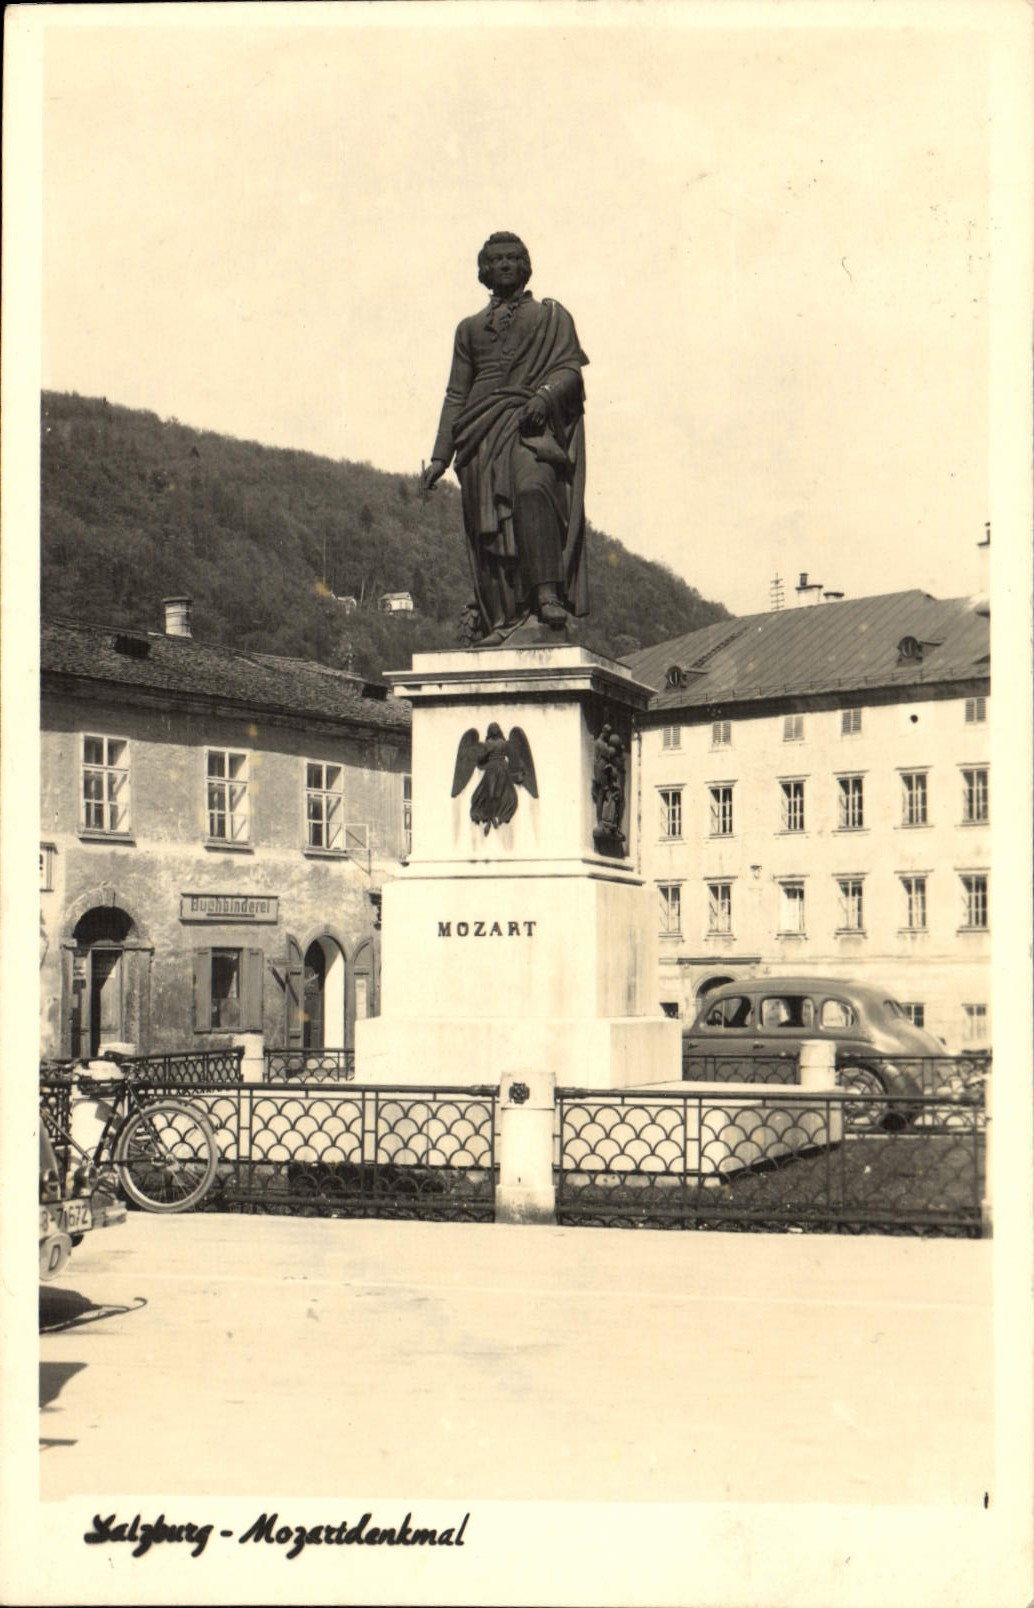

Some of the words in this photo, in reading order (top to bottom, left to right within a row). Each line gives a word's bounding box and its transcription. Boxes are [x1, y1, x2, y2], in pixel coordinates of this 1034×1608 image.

[191, 896, 270, 913] Buchbinderei
[438, 921, 537, 937] MOZART
[48, 1244, 61, 1272] D
